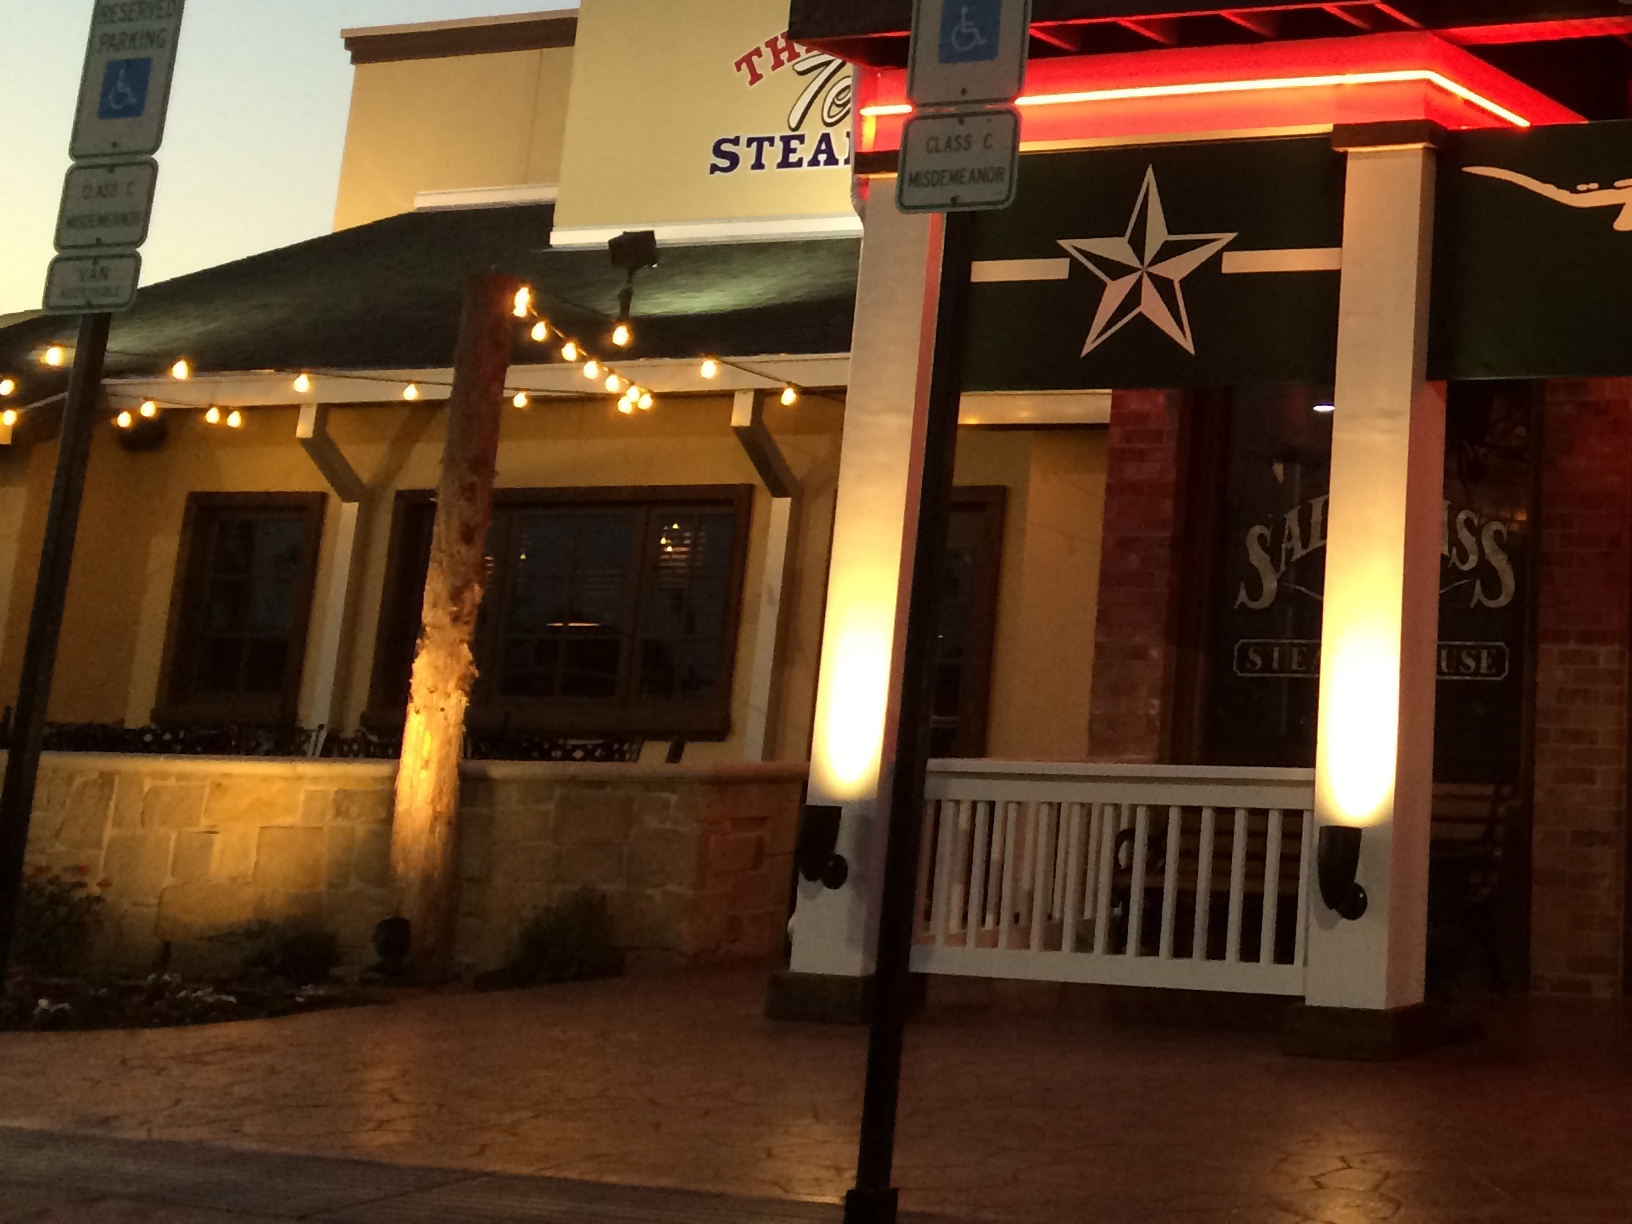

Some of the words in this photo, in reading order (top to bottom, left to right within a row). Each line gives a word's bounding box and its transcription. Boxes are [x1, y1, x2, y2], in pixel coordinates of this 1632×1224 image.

[97, 28, 167, 53] PARKING
[734, 30, 818, 87] TH
[709, 131, 850, 175] STEA
[926, 134, 972, 154] CLASS
[983, 133, 993, 150] C
[908, 166, 1006, 188] MISDEMEANOR
